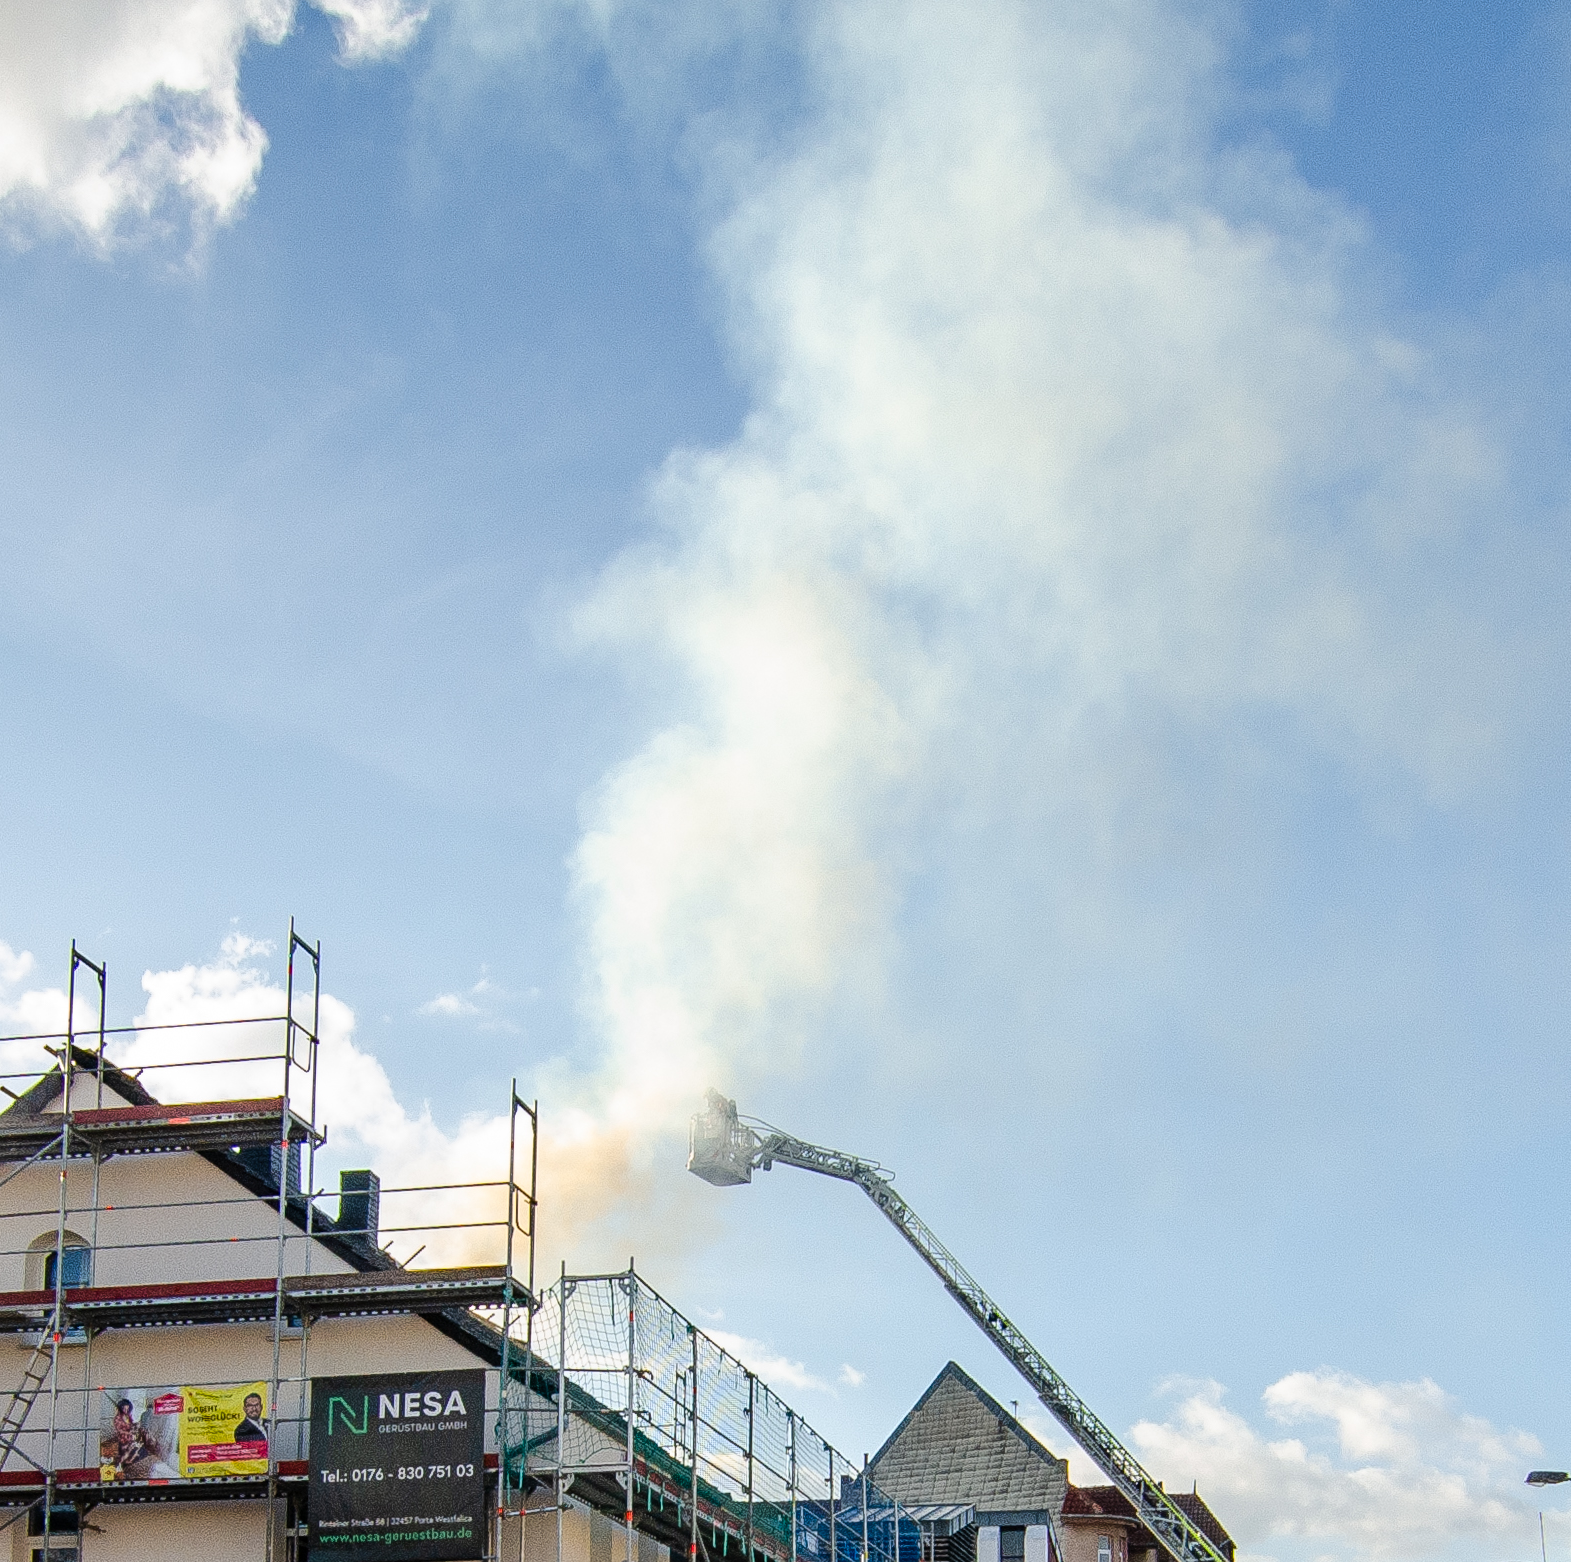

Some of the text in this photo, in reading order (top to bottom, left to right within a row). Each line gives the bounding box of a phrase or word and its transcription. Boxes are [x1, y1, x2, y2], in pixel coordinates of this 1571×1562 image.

[379, 1390, 467, 1419] NESA
[378, 1421, 468, 1434] GERÜSTBAU GMBH
[321, 1469, 348, 1483] Tel.:
[352, 1467, 384, 1482] 0176
[397, 1466, 424, 1480] 830
[428, 1464, 451, 1479] 751
[456, 1463, 474, 1478] 03
[319, 1526, 473, 1545] www.nesa-geruestbau.de
